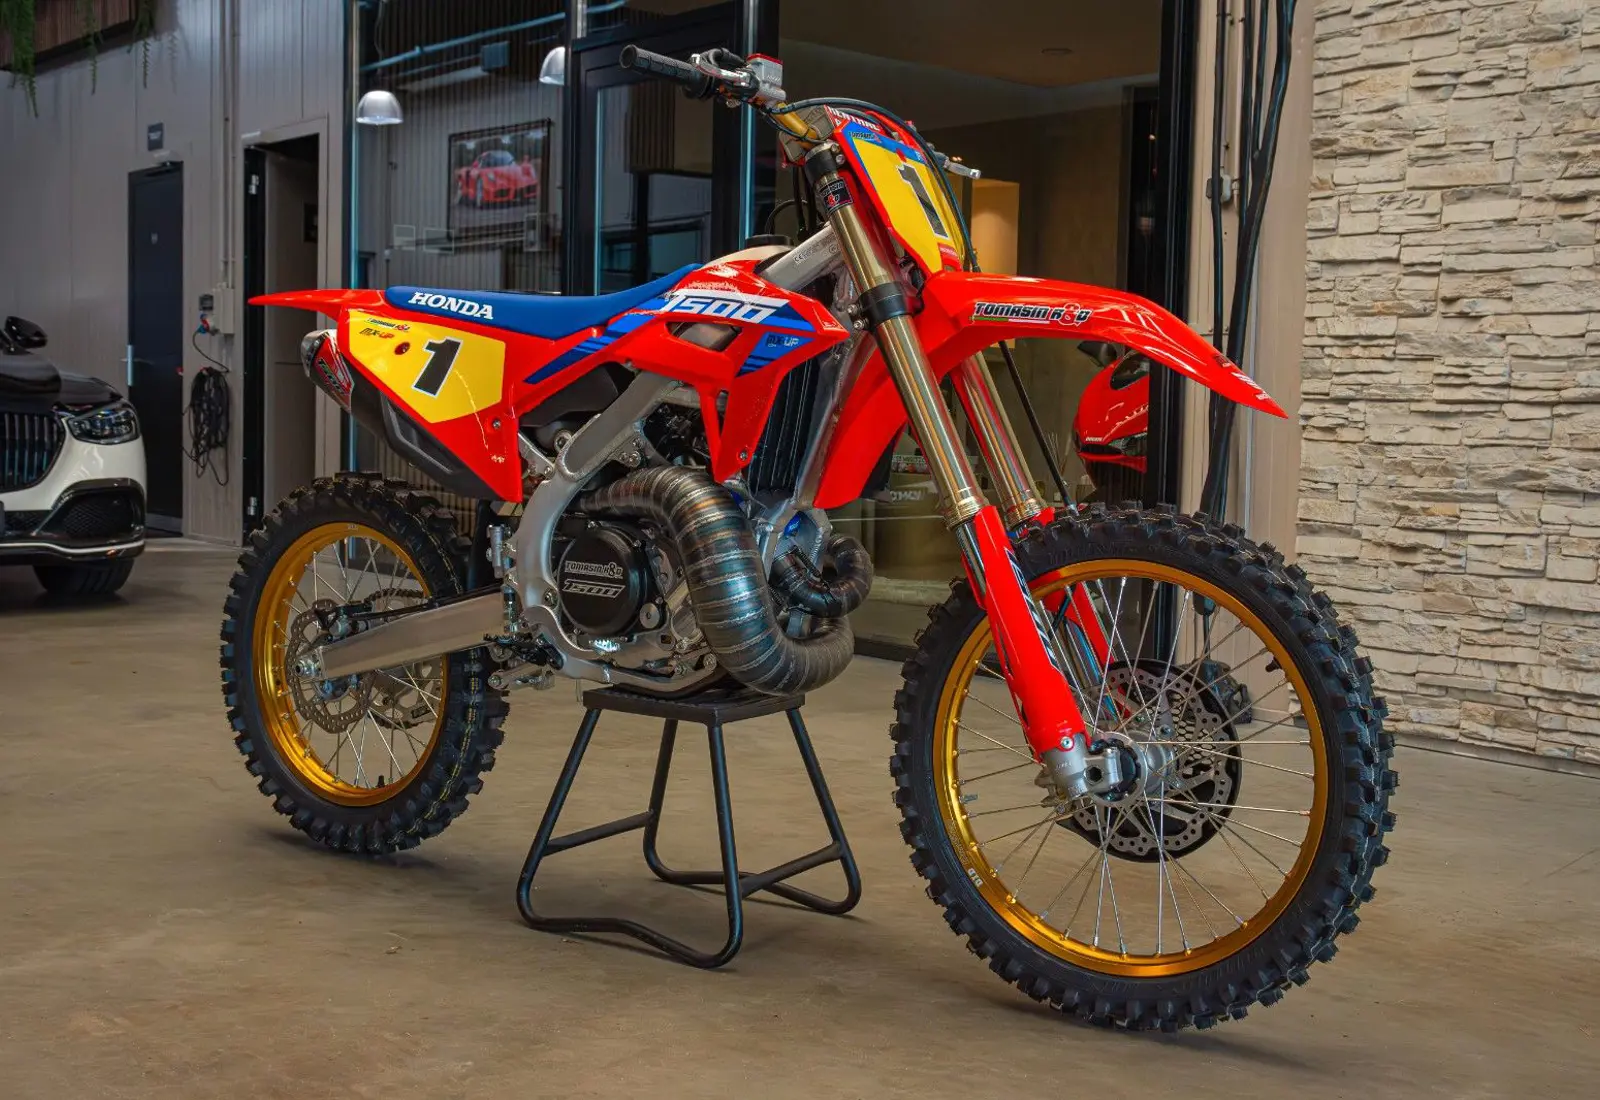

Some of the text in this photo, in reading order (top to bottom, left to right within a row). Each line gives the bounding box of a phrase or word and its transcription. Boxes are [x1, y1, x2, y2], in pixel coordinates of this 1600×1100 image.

[896, 161, 951, 240] 1
[408, 291, 494, 320] HONDA
[659, 288, 790, 324] 1500
[974, 301, 1093, 326] TOMASIN R&D
[411, 336, 464, 398] 1
[565, 560, 603, 576] TOMASIN
